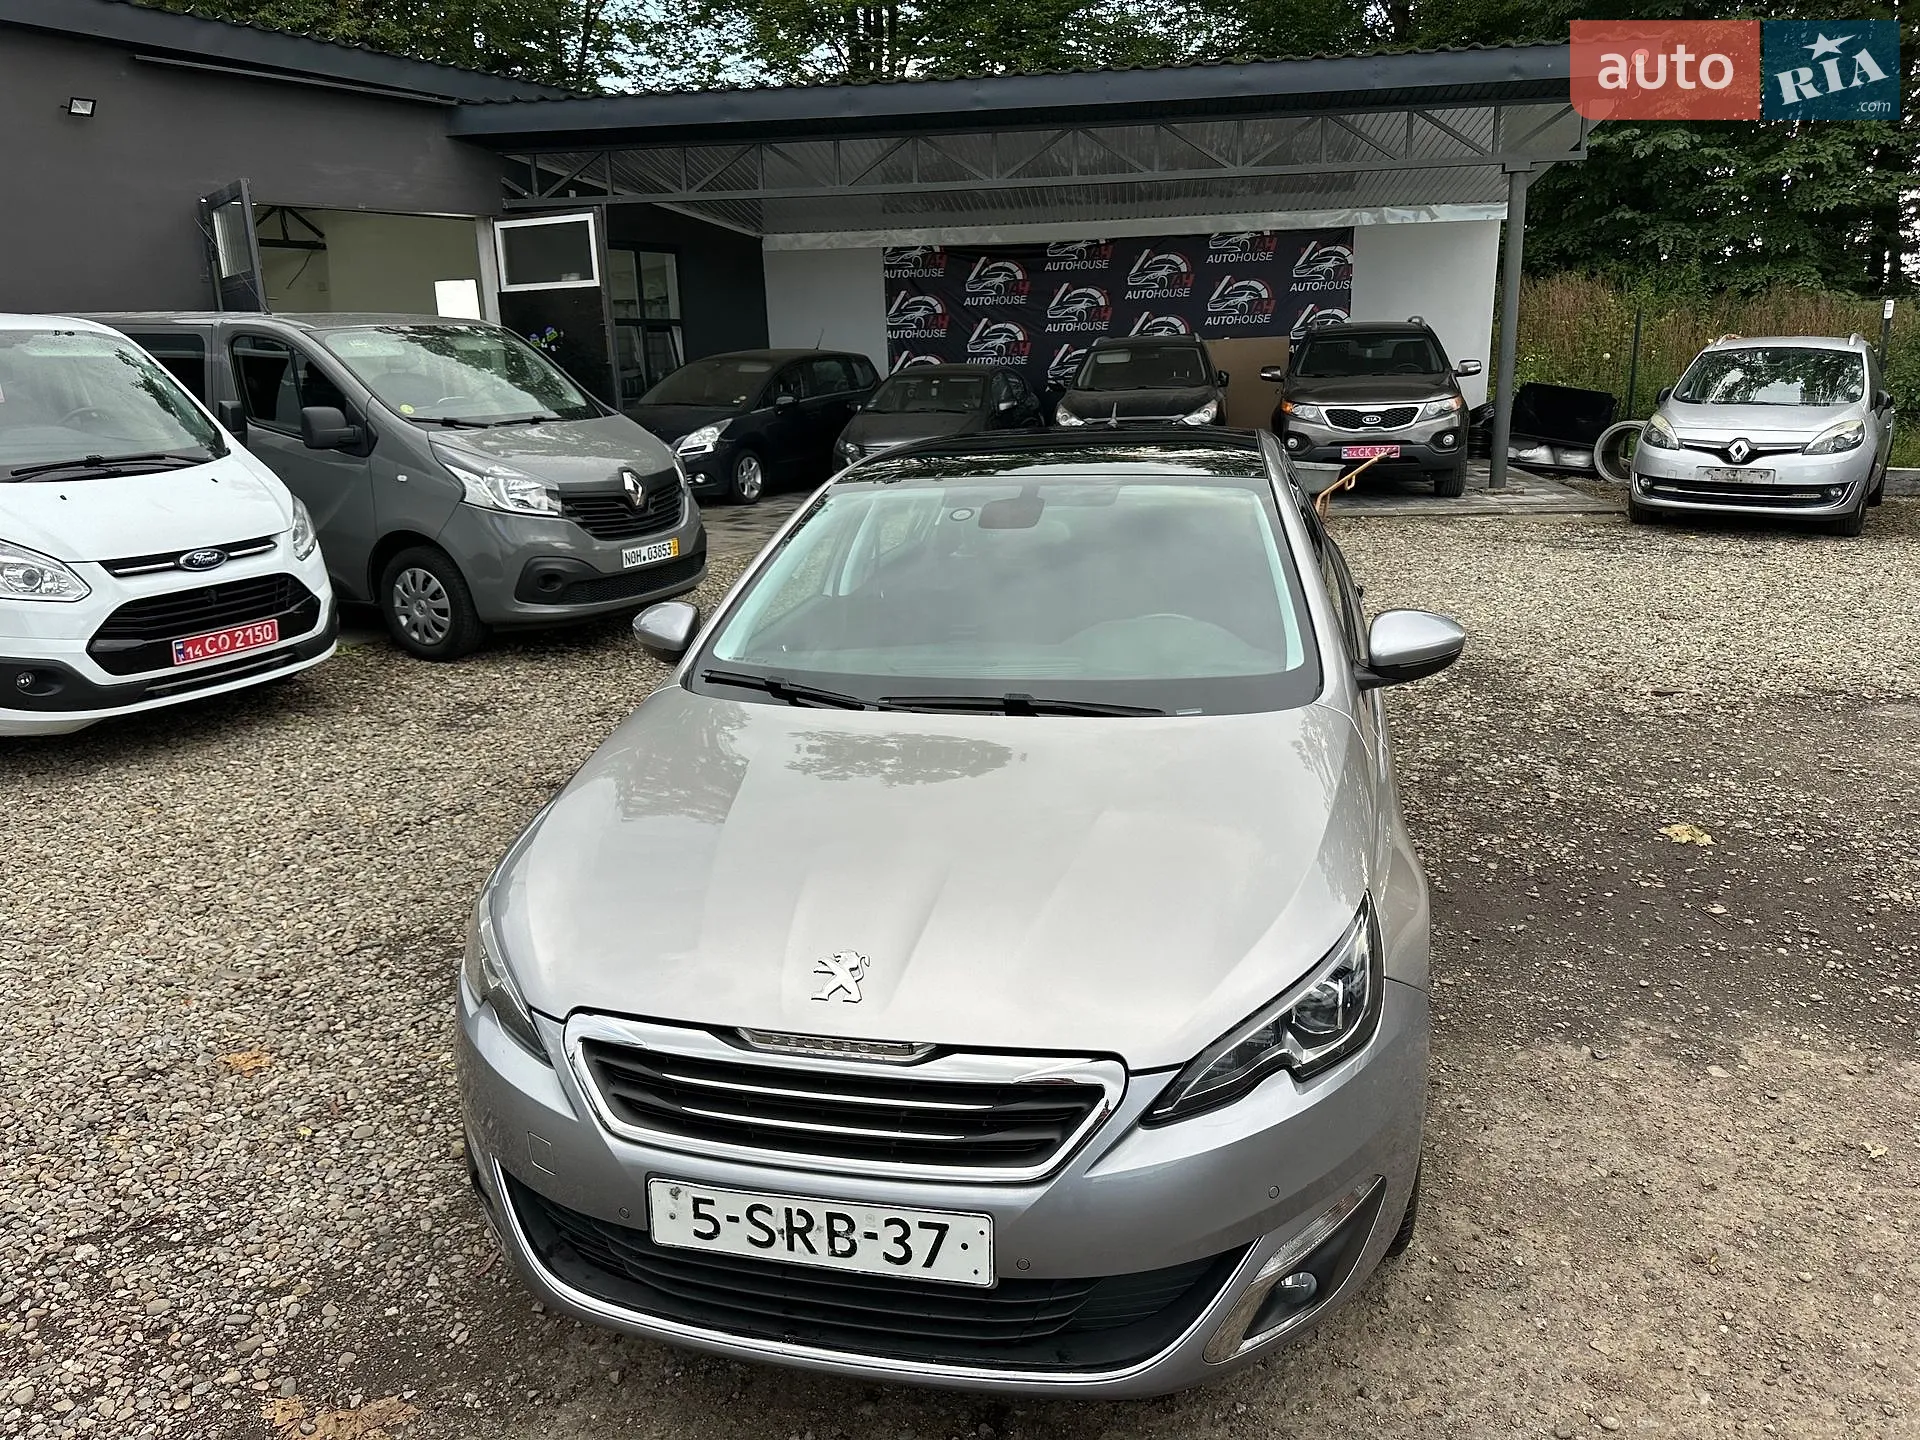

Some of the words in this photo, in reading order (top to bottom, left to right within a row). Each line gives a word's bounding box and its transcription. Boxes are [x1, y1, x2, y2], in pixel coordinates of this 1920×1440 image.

[1206, 252, 1273, 264] AUTOHOUSE
[1045, 260, 1109, 271] AUTOHOUSE
[884, 268, 944, 279] AUTOHOUSE
[1125, 288, 1191, 300] AUTOHOUSE
[964, 296, 1027, 306] AUTOHOUSE
[1205, 314, 1272, 325] AUTOHOUSE
[1045, 321, 1109, 332] AUTOHOUSE
[887, 329, 947, 339] AUTOHOUSE
[967, 356, 1028, 365] AUTOHOUSE
[1358, 448, 1371, 457] CK
[193, 551, 218, 565] Ford
[186, 645, 203, 660] 14
[205, 634, 230, 654] CO
[235, 624, 273, 648] 2150
[691, 1196, 950, 1269] 5-SRB-37
